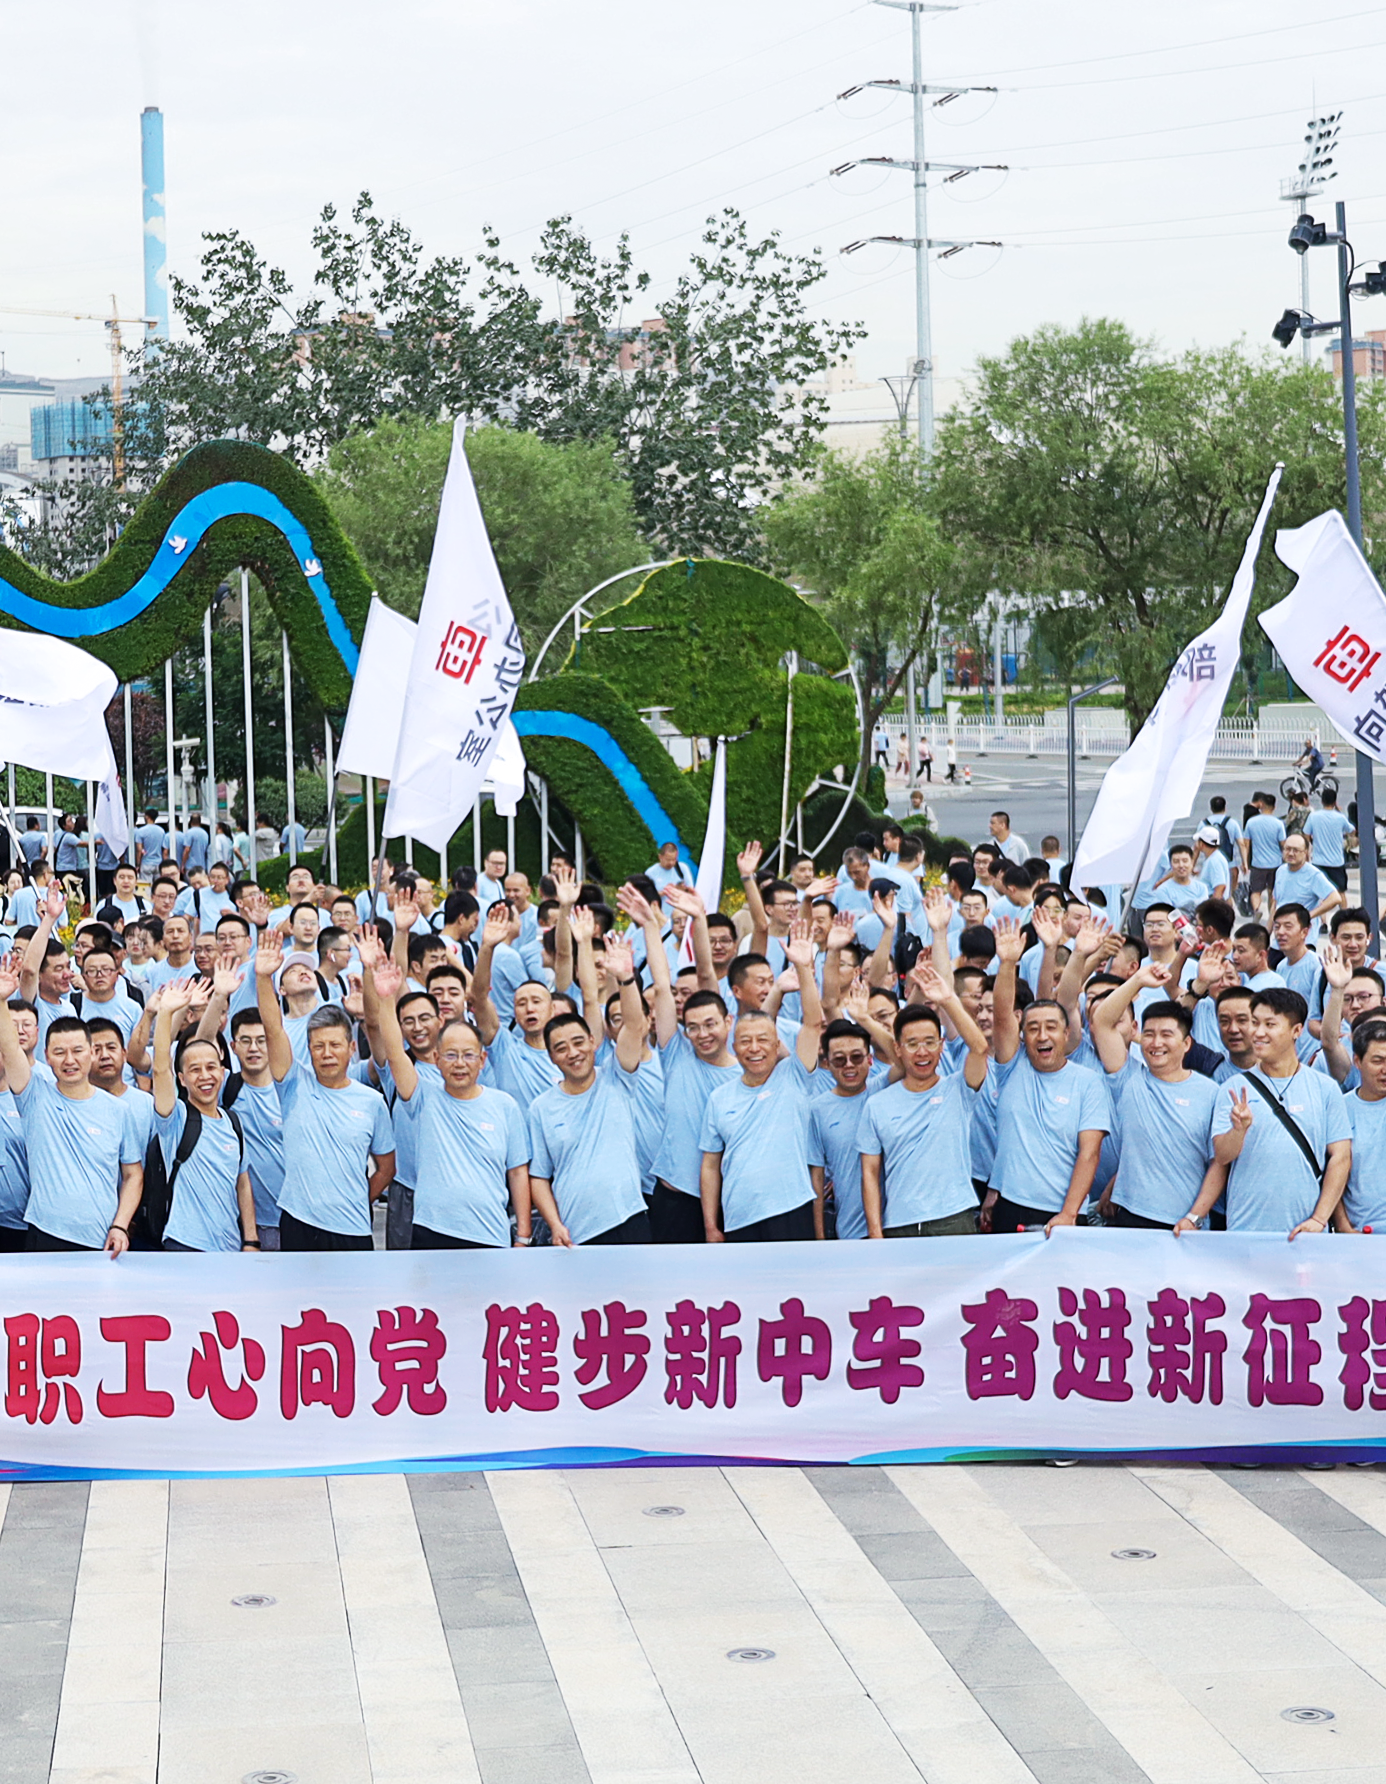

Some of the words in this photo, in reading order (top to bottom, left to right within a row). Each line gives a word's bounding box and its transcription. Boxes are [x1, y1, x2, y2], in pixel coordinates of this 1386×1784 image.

[483, 1296, 925, 1413] 健步新中车
